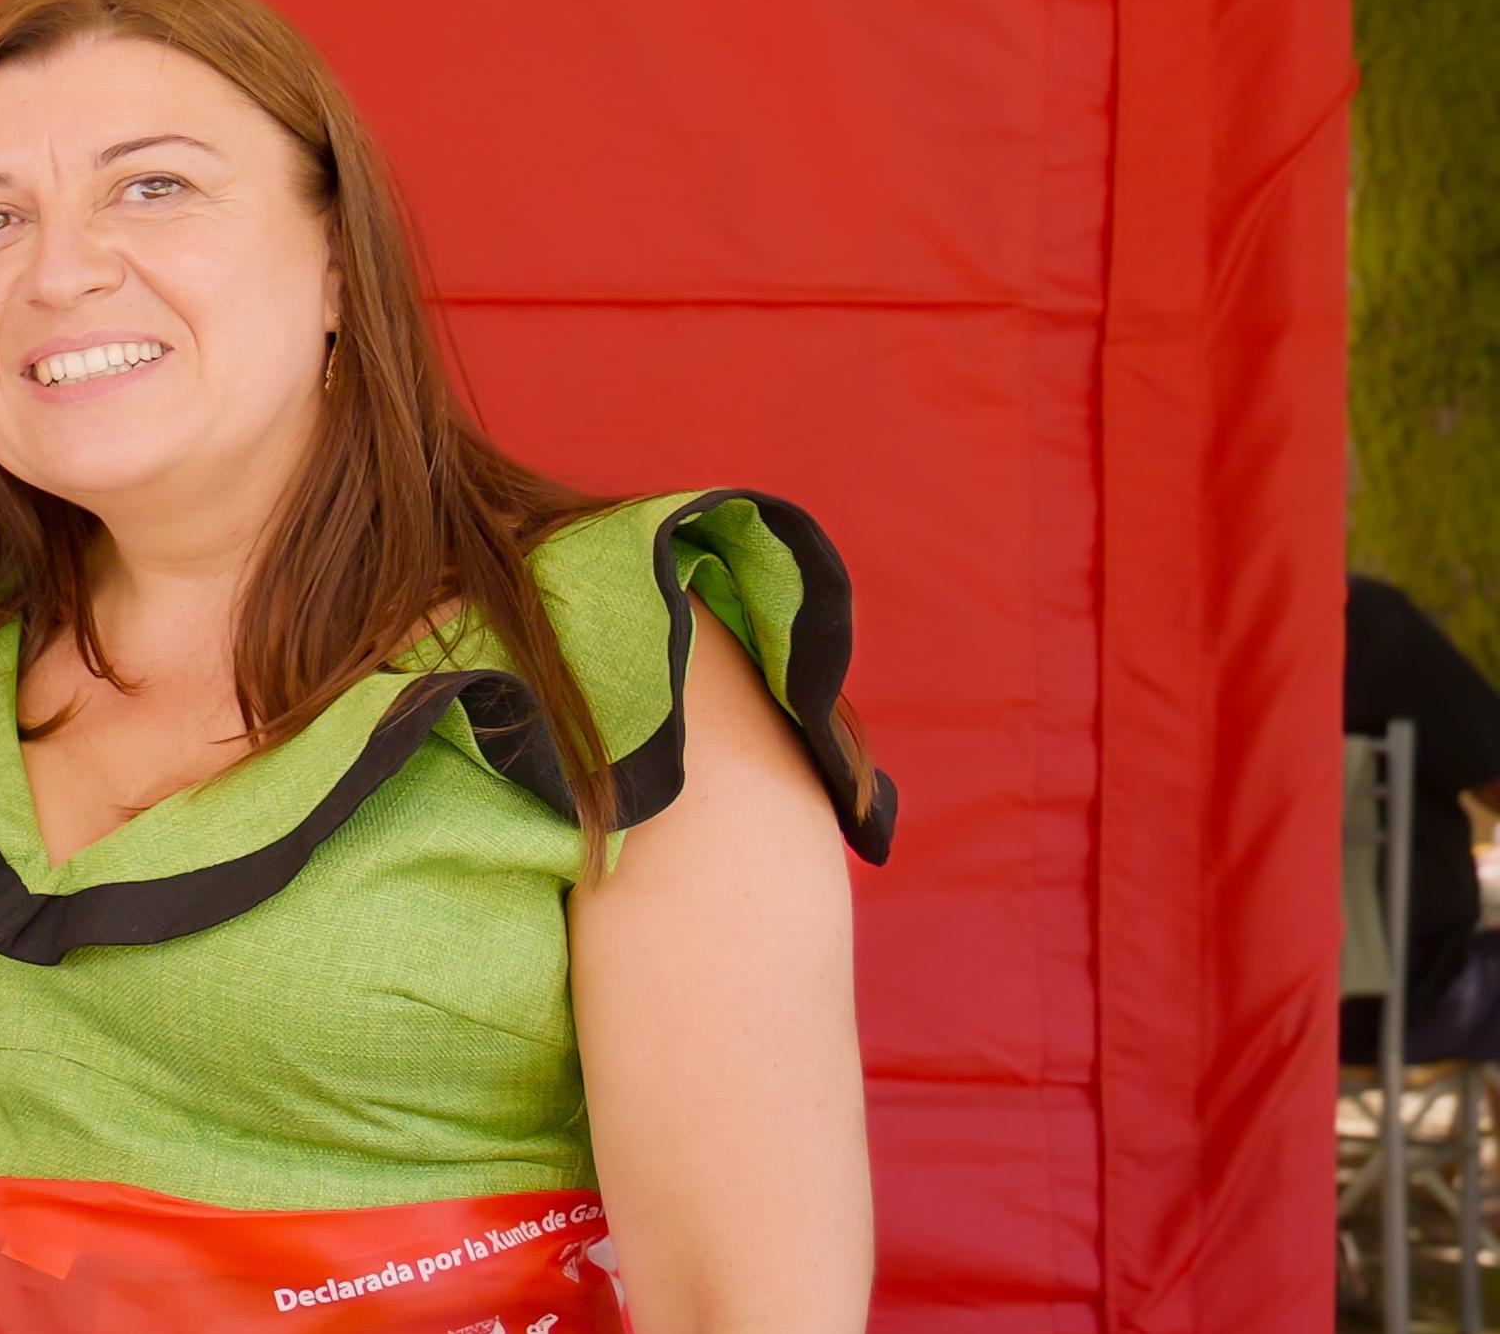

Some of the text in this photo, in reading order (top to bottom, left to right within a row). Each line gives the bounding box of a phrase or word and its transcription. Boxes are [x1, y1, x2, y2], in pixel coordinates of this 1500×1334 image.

[274, 1261, 414, 1313] Declarada
[418, 1246, 463, 1283] por
[464, 1238, 489, 1261] la
[487, 1218, 542, 1255] Xunta
[541, 1209, 567, 1233] de
